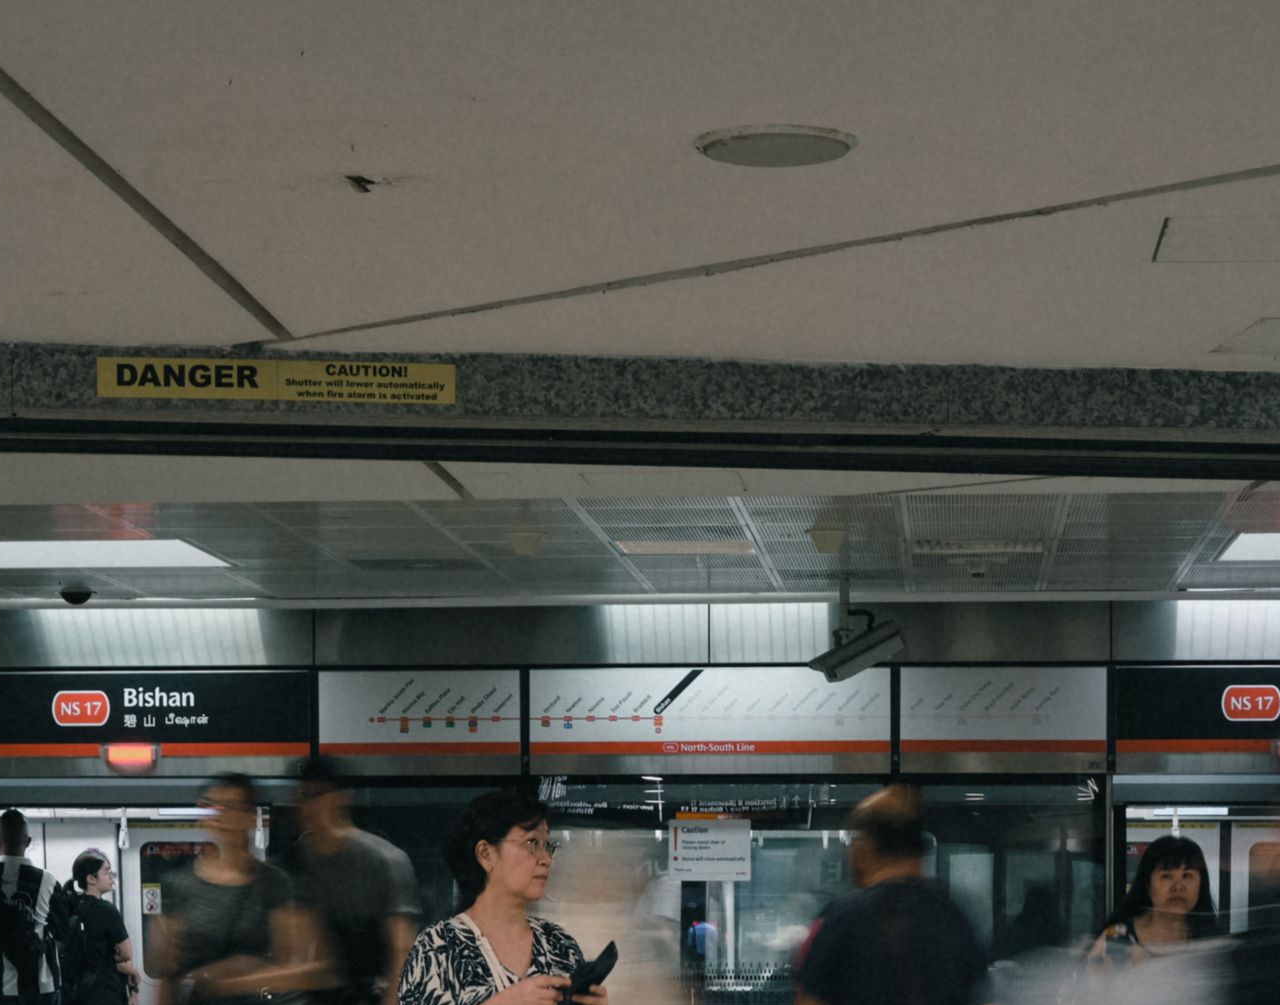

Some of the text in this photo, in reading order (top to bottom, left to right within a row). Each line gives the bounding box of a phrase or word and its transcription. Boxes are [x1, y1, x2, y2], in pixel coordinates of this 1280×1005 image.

[116, 364, 258, 389] DANGER
[325, 363, 408, 378] CAUTION!
[285, 378, 445, 392] Shutter will lower automatically
[296, 390, 438, 401] when fire alarm is activated
[123, 686, 195, 707] Bishan
[1231, 696, 1274, 710] NS 17
[60, 702, 102, 716] NS 17
[681, 742, 734, 752] North-South
[736, 742, 755, 752] Line
